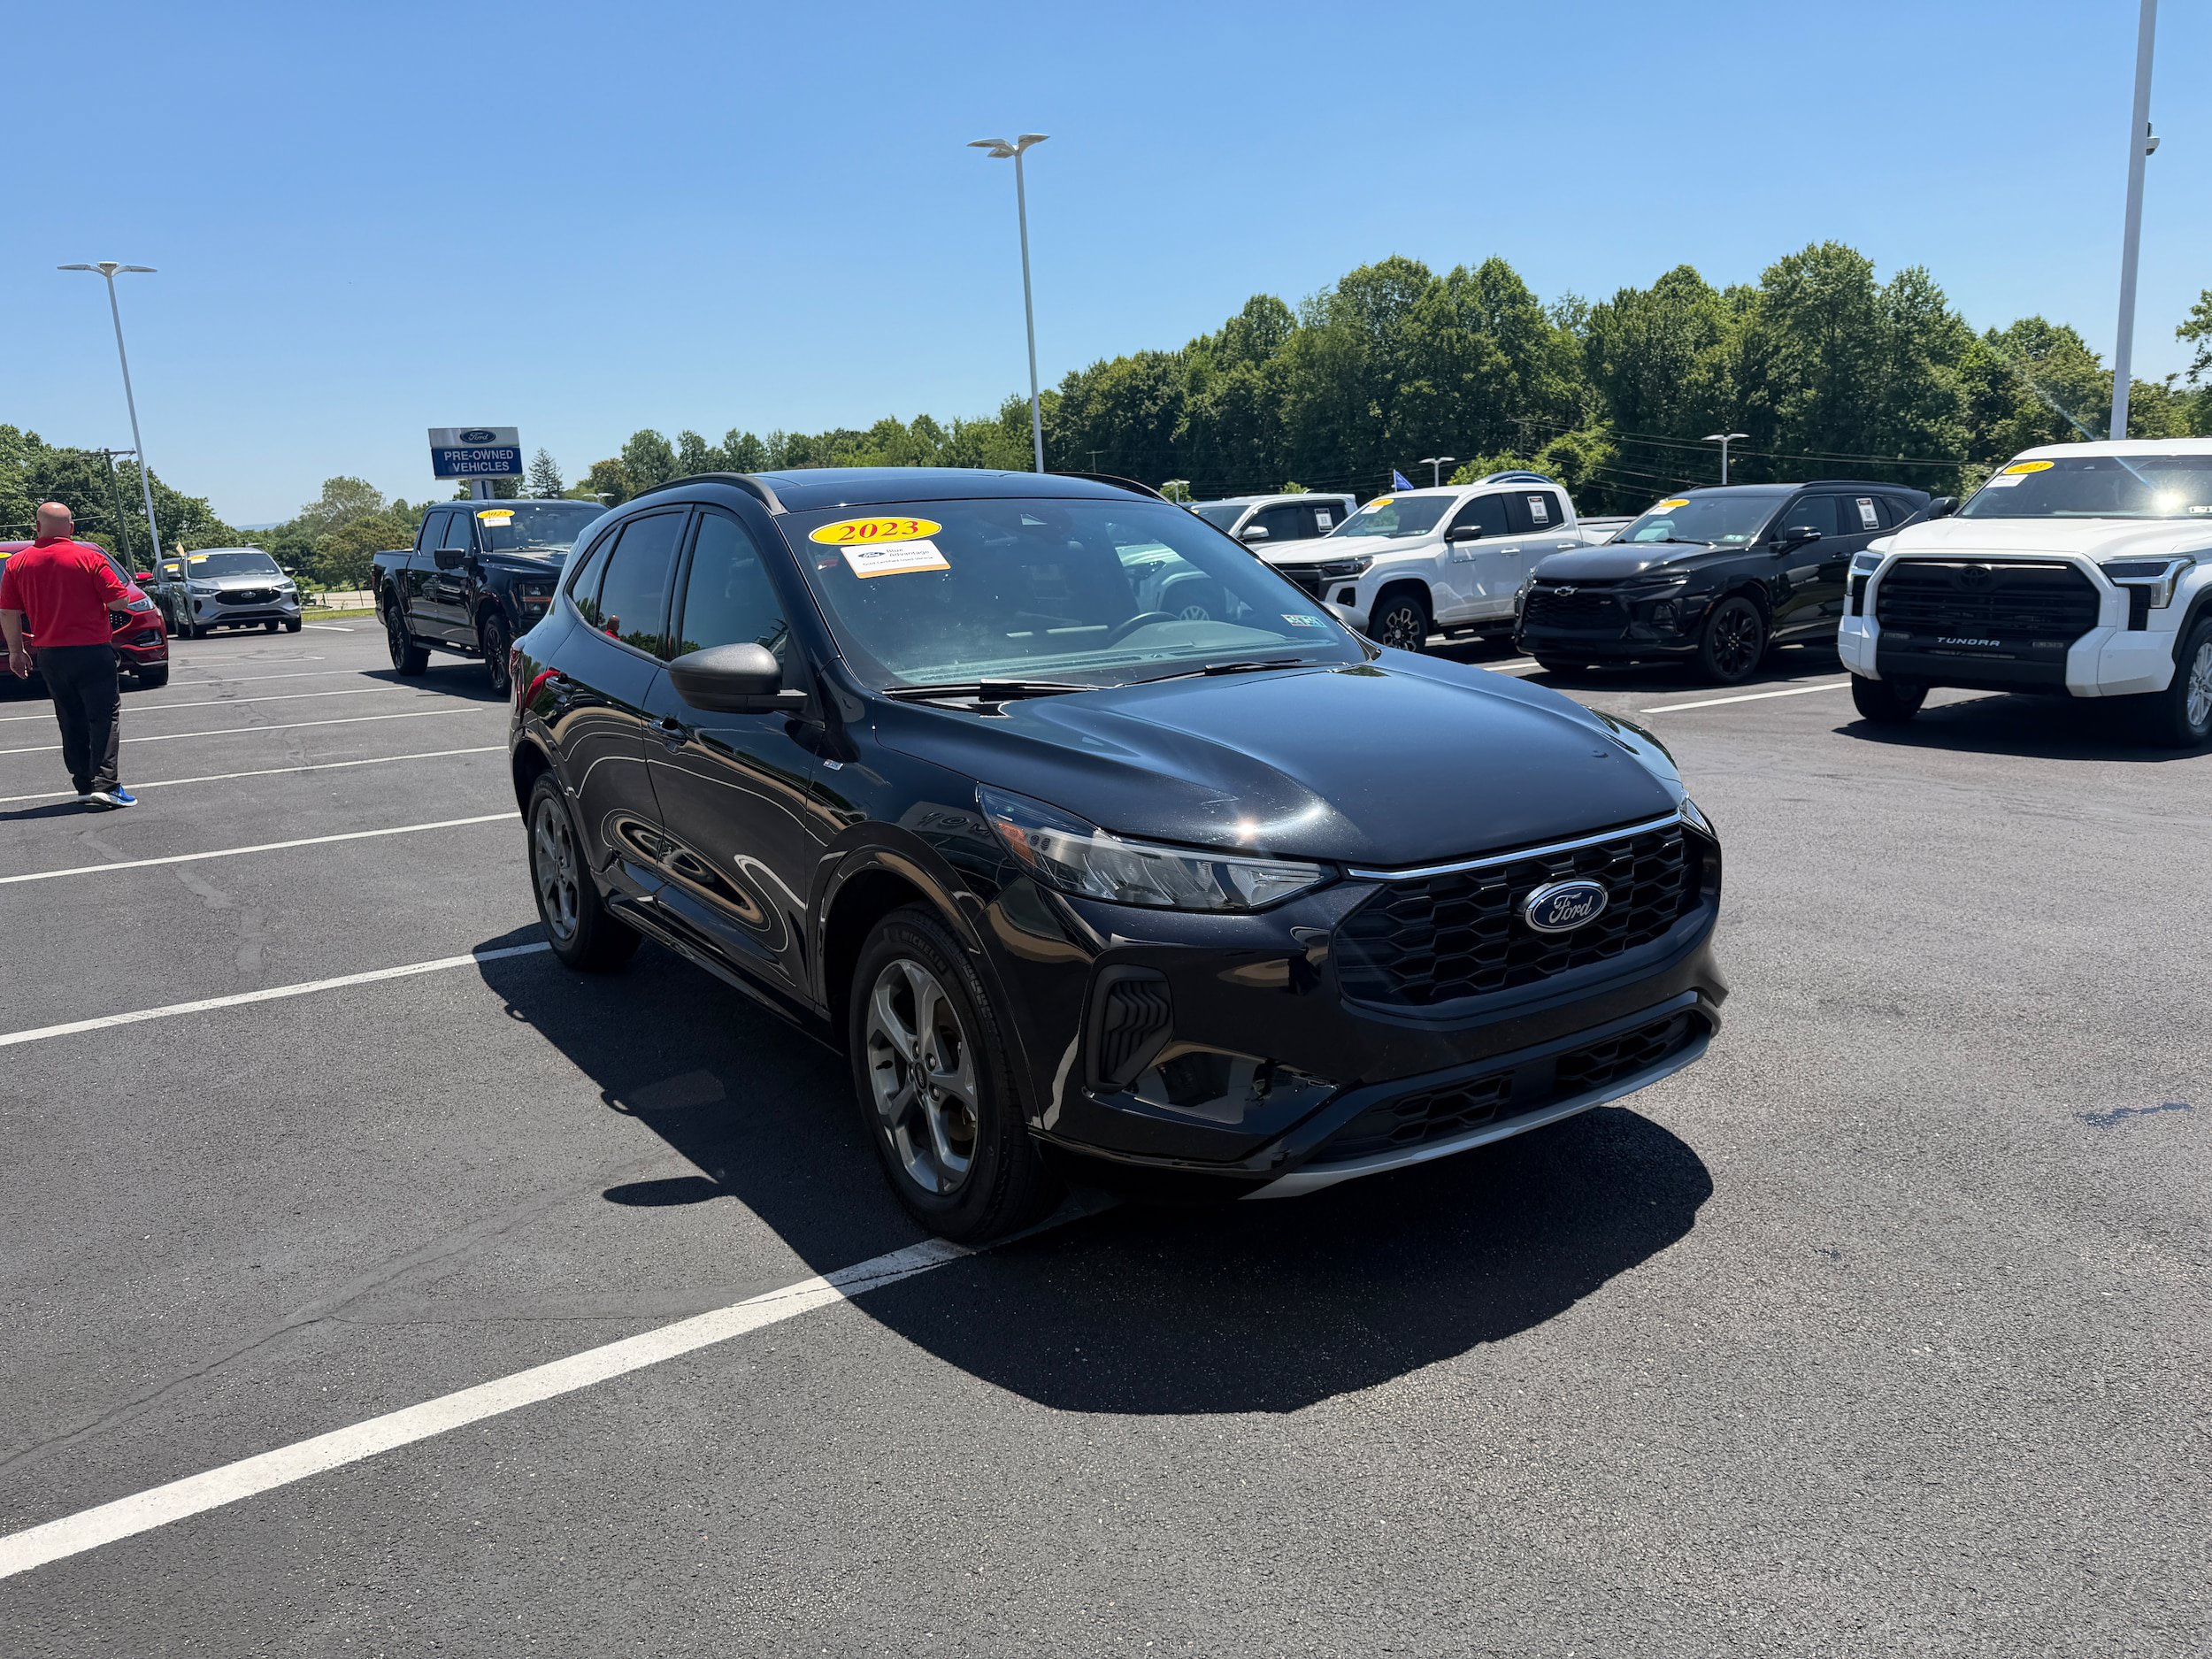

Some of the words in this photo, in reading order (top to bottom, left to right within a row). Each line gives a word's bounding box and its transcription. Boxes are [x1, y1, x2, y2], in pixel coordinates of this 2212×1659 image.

[468, 432, 489, 441] Ford
[444, 449, 513, 461] PRE-OWNED
[452, 461, 510, 472] VEHICLES
[838, 520, 918, 541] 2023
[1937, 636, 2001, 647] TUNDRA
[1548, 892, 1594, 924] Ford
[901, 931, 948, 973] MICHELIN
